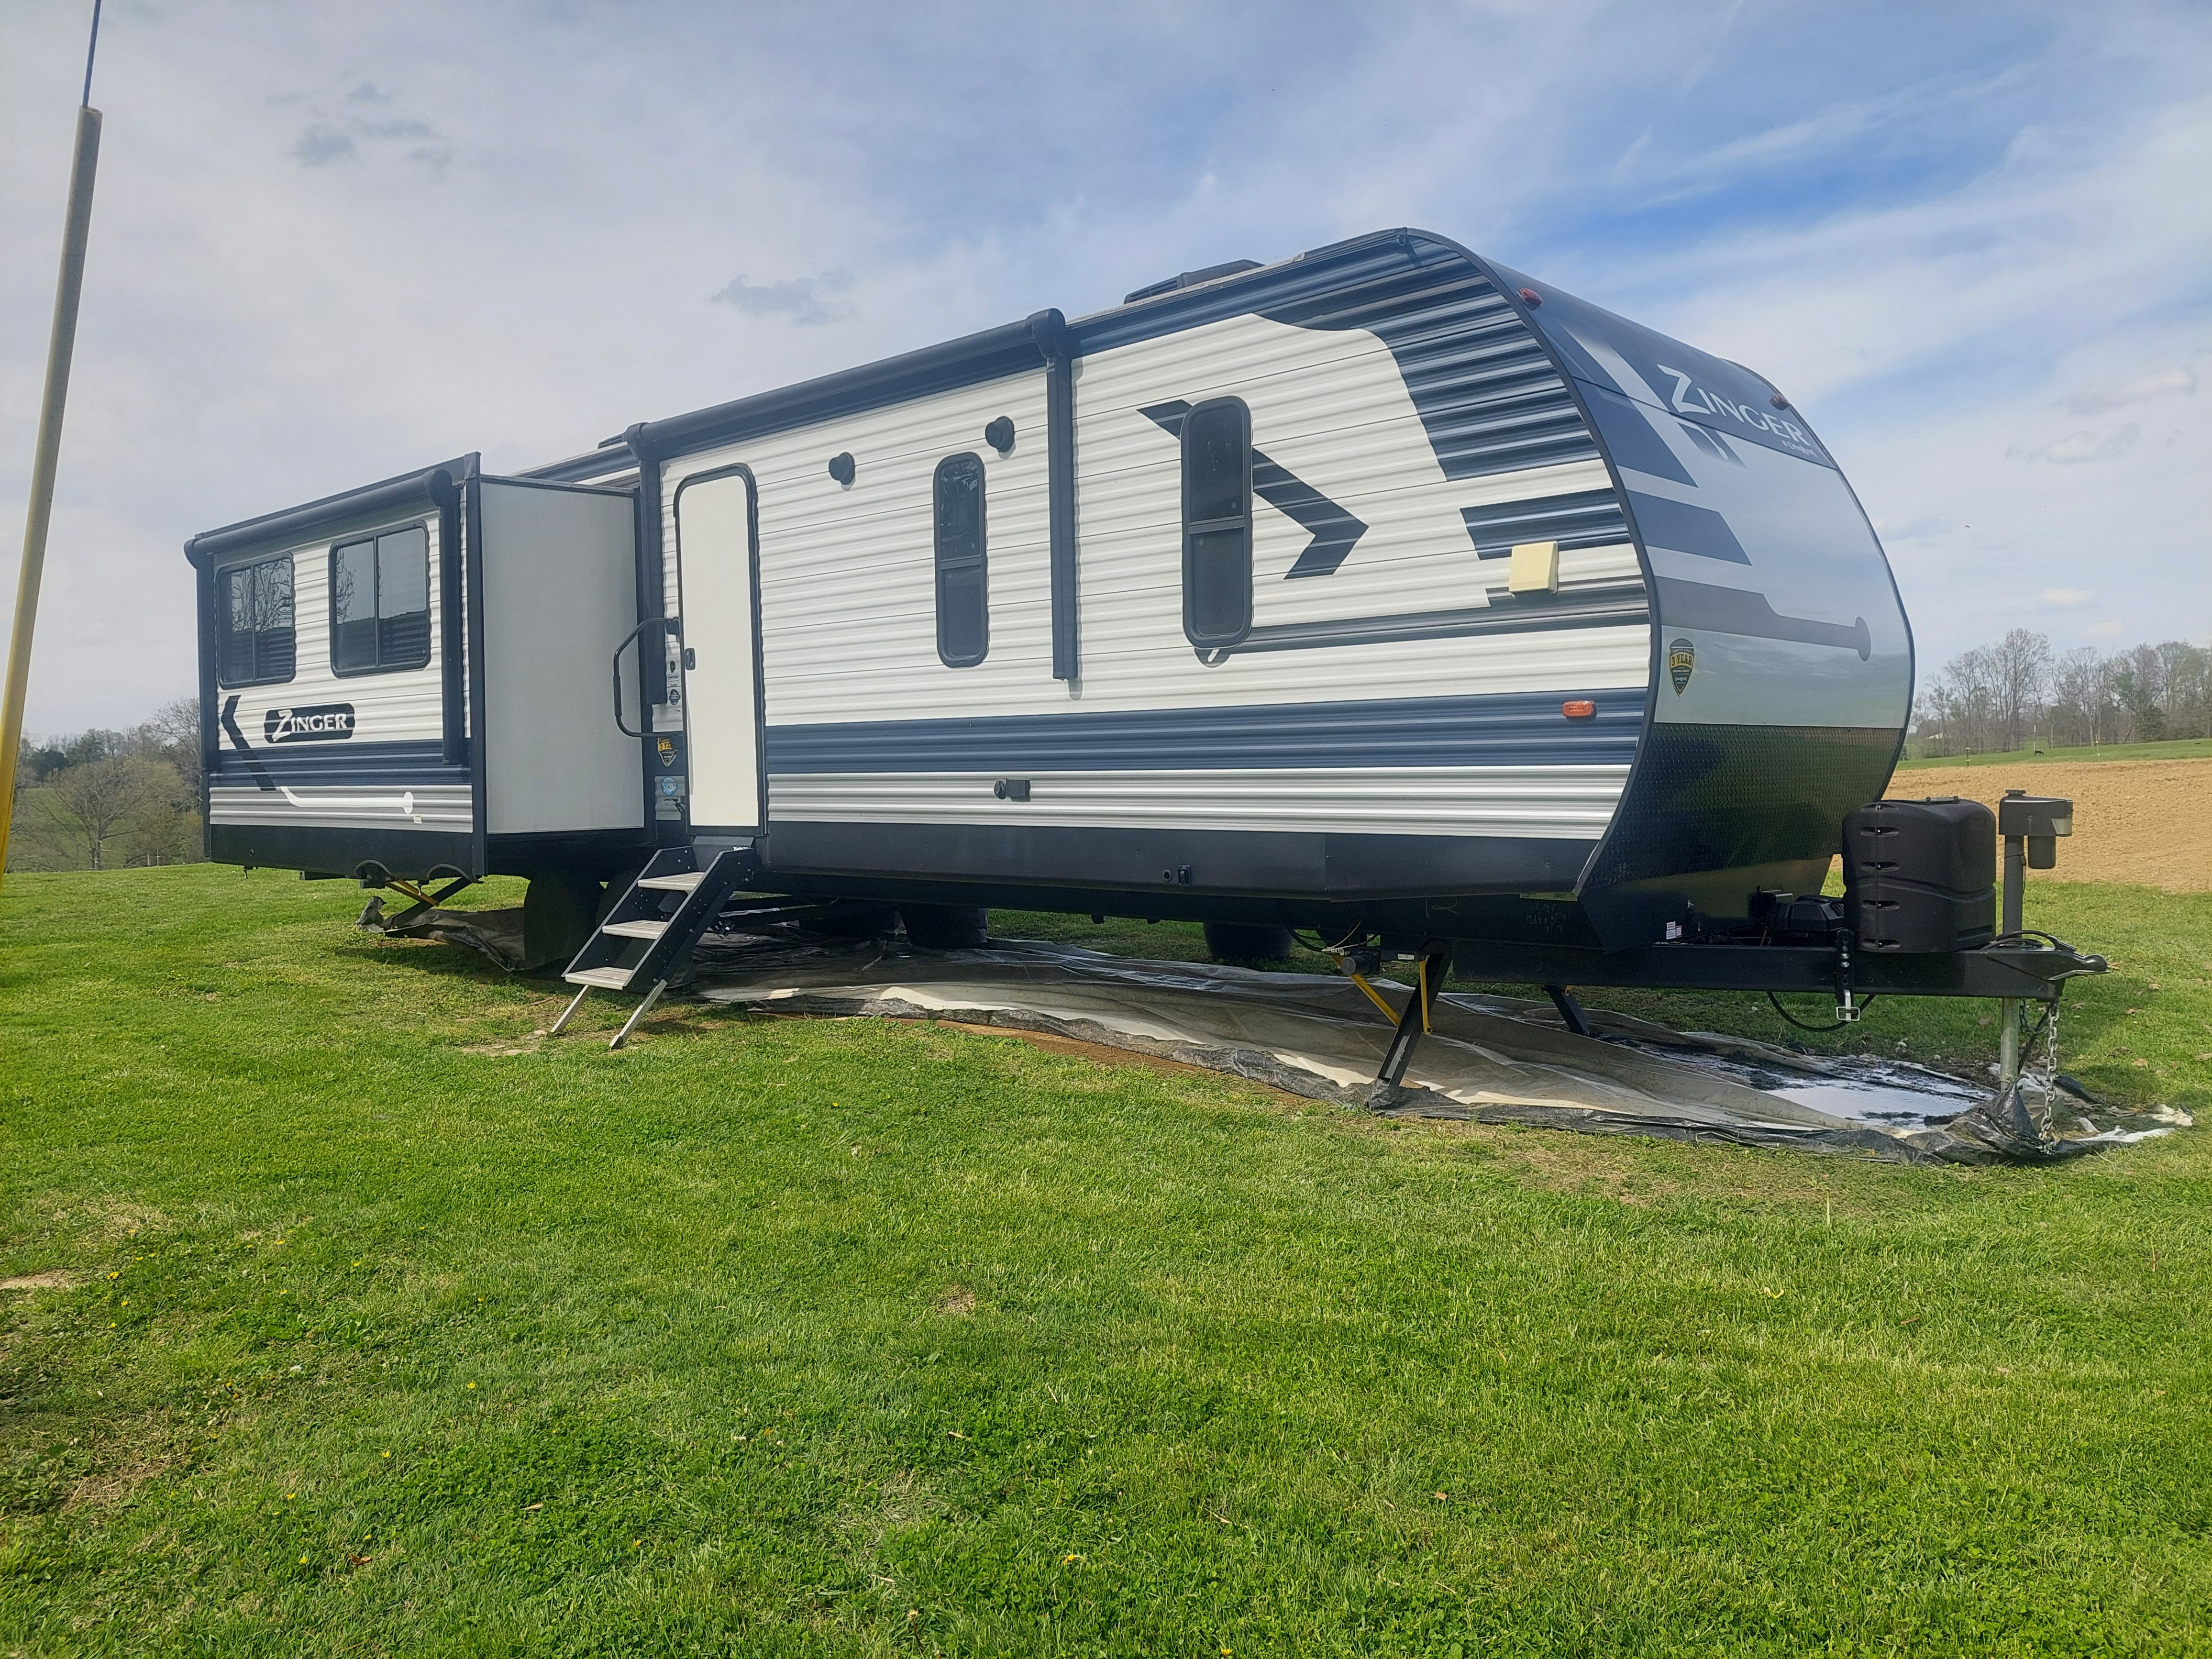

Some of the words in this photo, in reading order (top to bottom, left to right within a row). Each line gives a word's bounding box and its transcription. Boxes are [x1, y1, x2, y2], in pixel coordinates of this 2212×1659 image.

[1657, 364, 1811, 446] ZINGER
[1672, 656, 1675, 666] 3
[1677, 654, 1692, 666] YEAR
[272, 709, 347, 742] ZINGER
